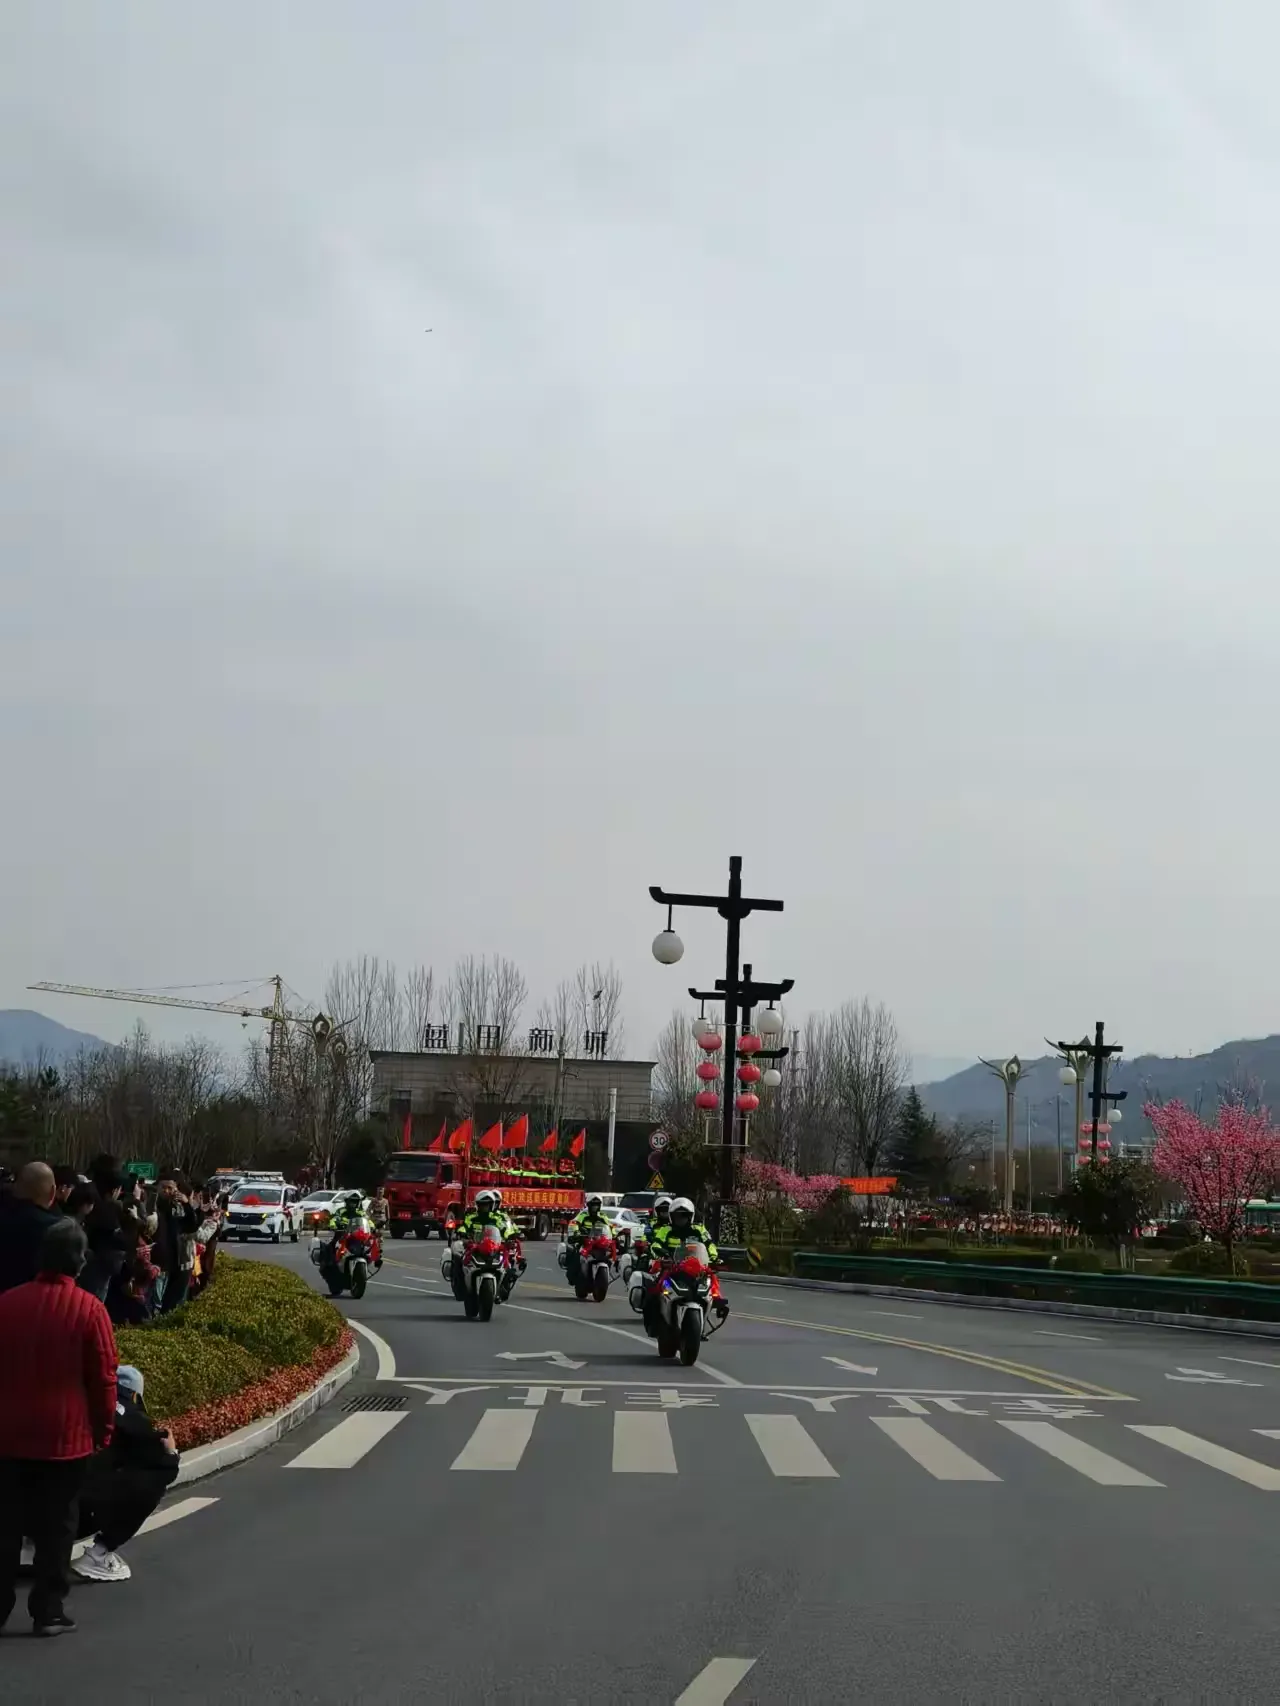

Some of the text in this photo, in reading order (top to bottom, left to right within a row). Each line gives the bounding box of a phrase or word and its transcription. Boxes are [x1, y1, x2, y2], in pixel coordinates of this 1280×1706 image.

[653, 1136, 666, 1146] 30
[401, 1384, 720, 1408] 车让人
[769, 1392, 1104, 1418] 车让人
